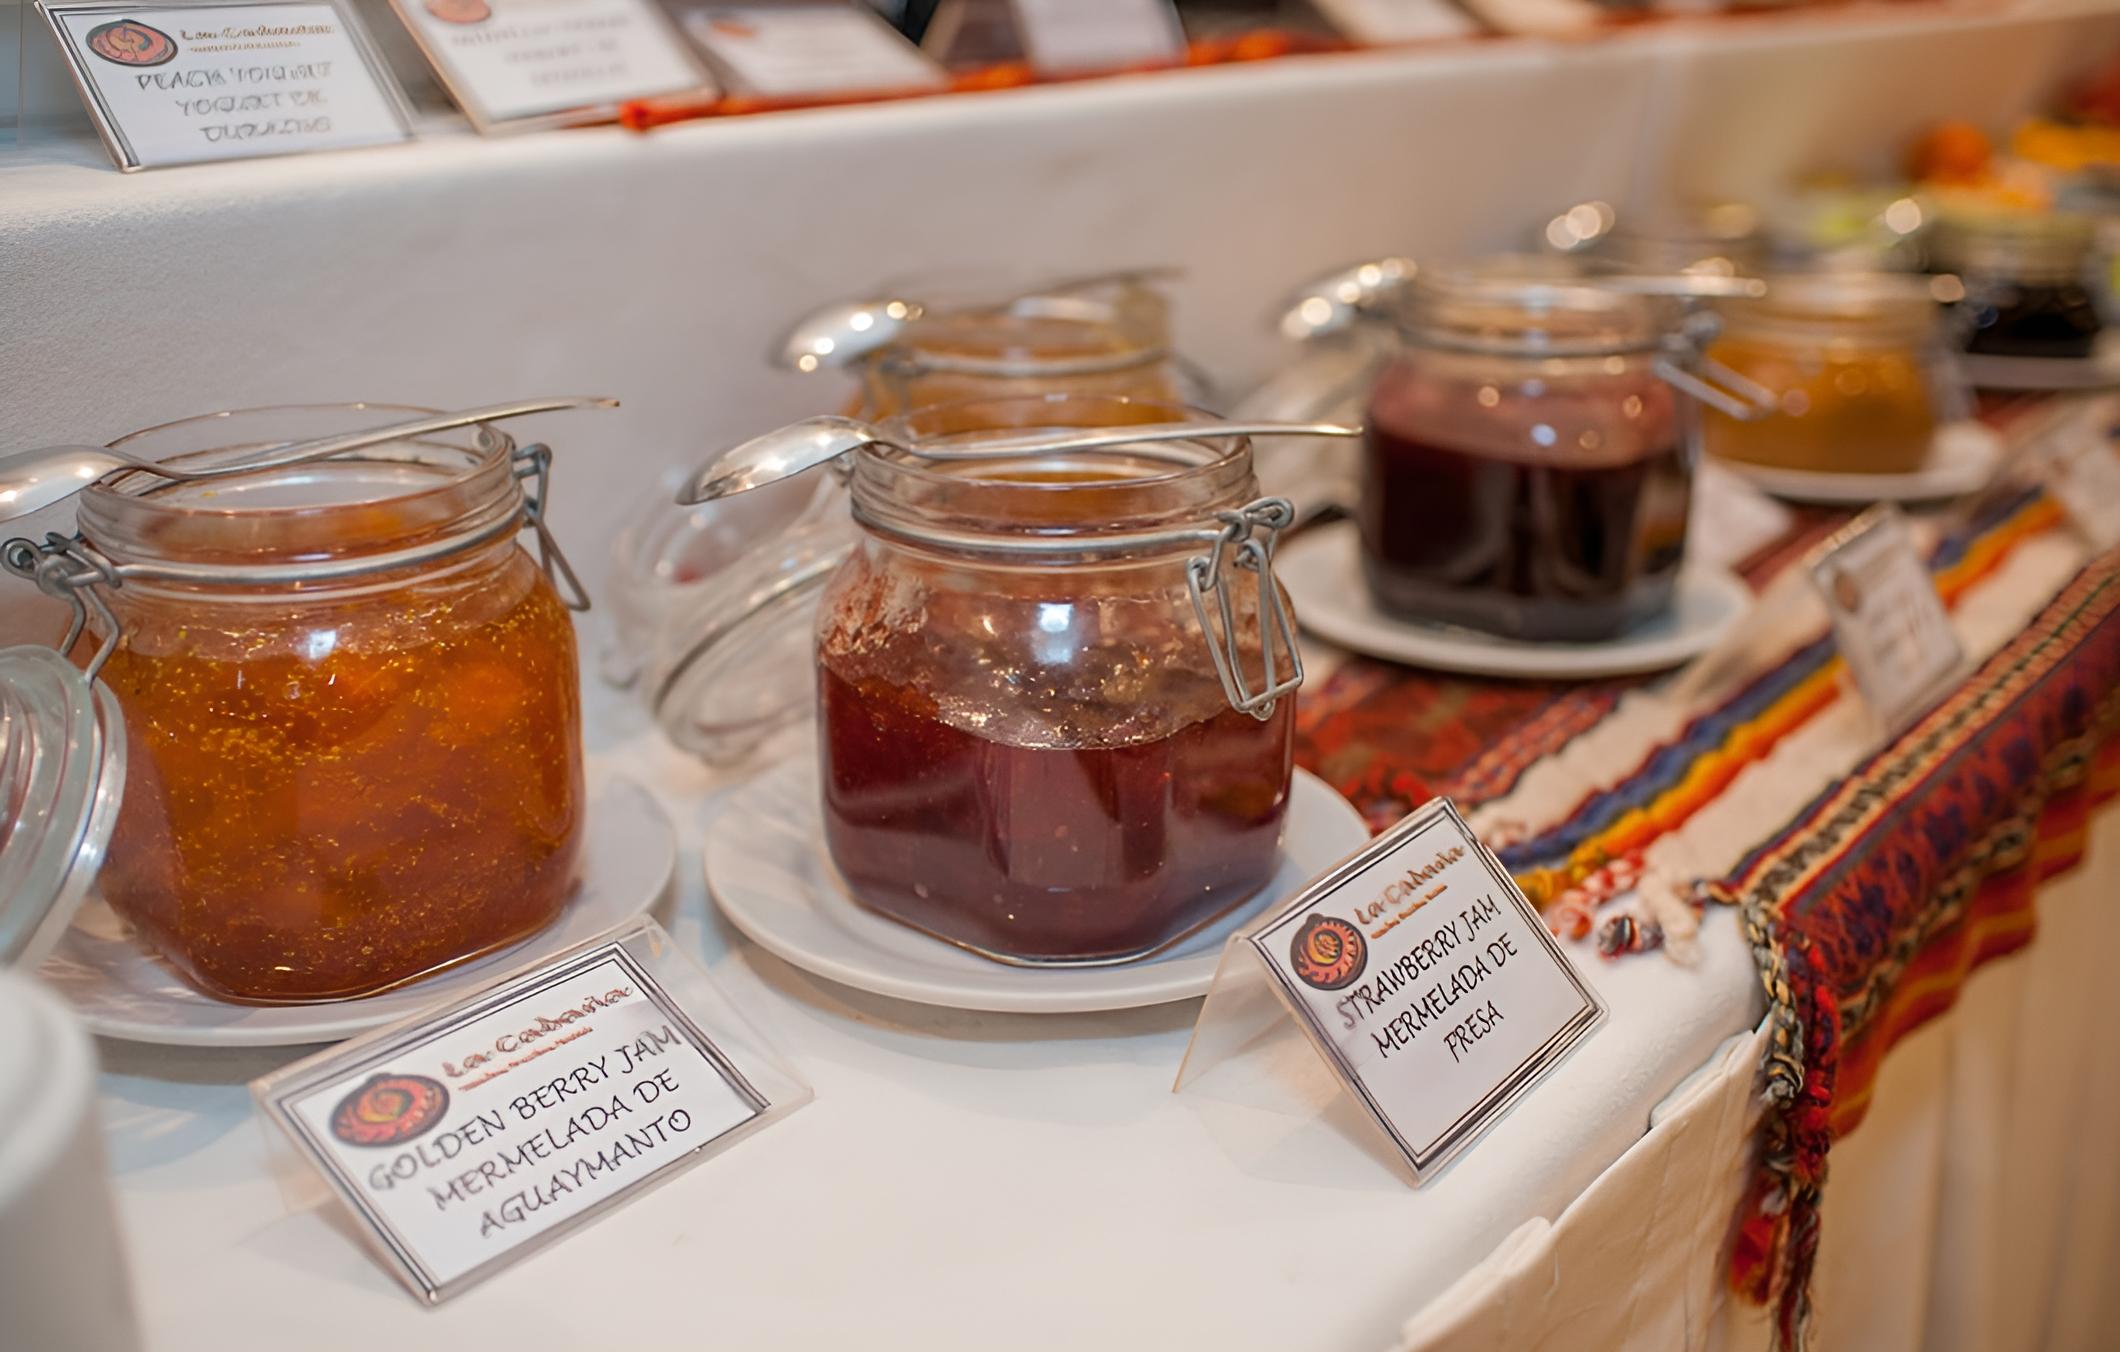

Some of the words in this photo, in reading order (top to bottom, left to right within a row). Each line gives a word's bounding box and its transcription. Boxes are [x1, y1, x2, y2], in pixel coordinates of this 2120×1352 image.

[1336, 920, 1462, 1030] STRAWBERRY
[1459, 894, 1502, 942] JAM
[1370, 955, 1492, 1059] MERMELADA
[1486, 932, 1518, 968] DE
[1443, 1000, 1505, 1064] FRESA
[369, 1109, 507, 1191] GOLDEN
[509, 1055, 610, 1120] BERRY
[613, 1024, 682, 1074] JAM
[427, 1095, 633, 1211] MERMELADA
[633, 1068, 680, 1104] DE
[479, 1109, 691, 1239] AGUAYMANTO
